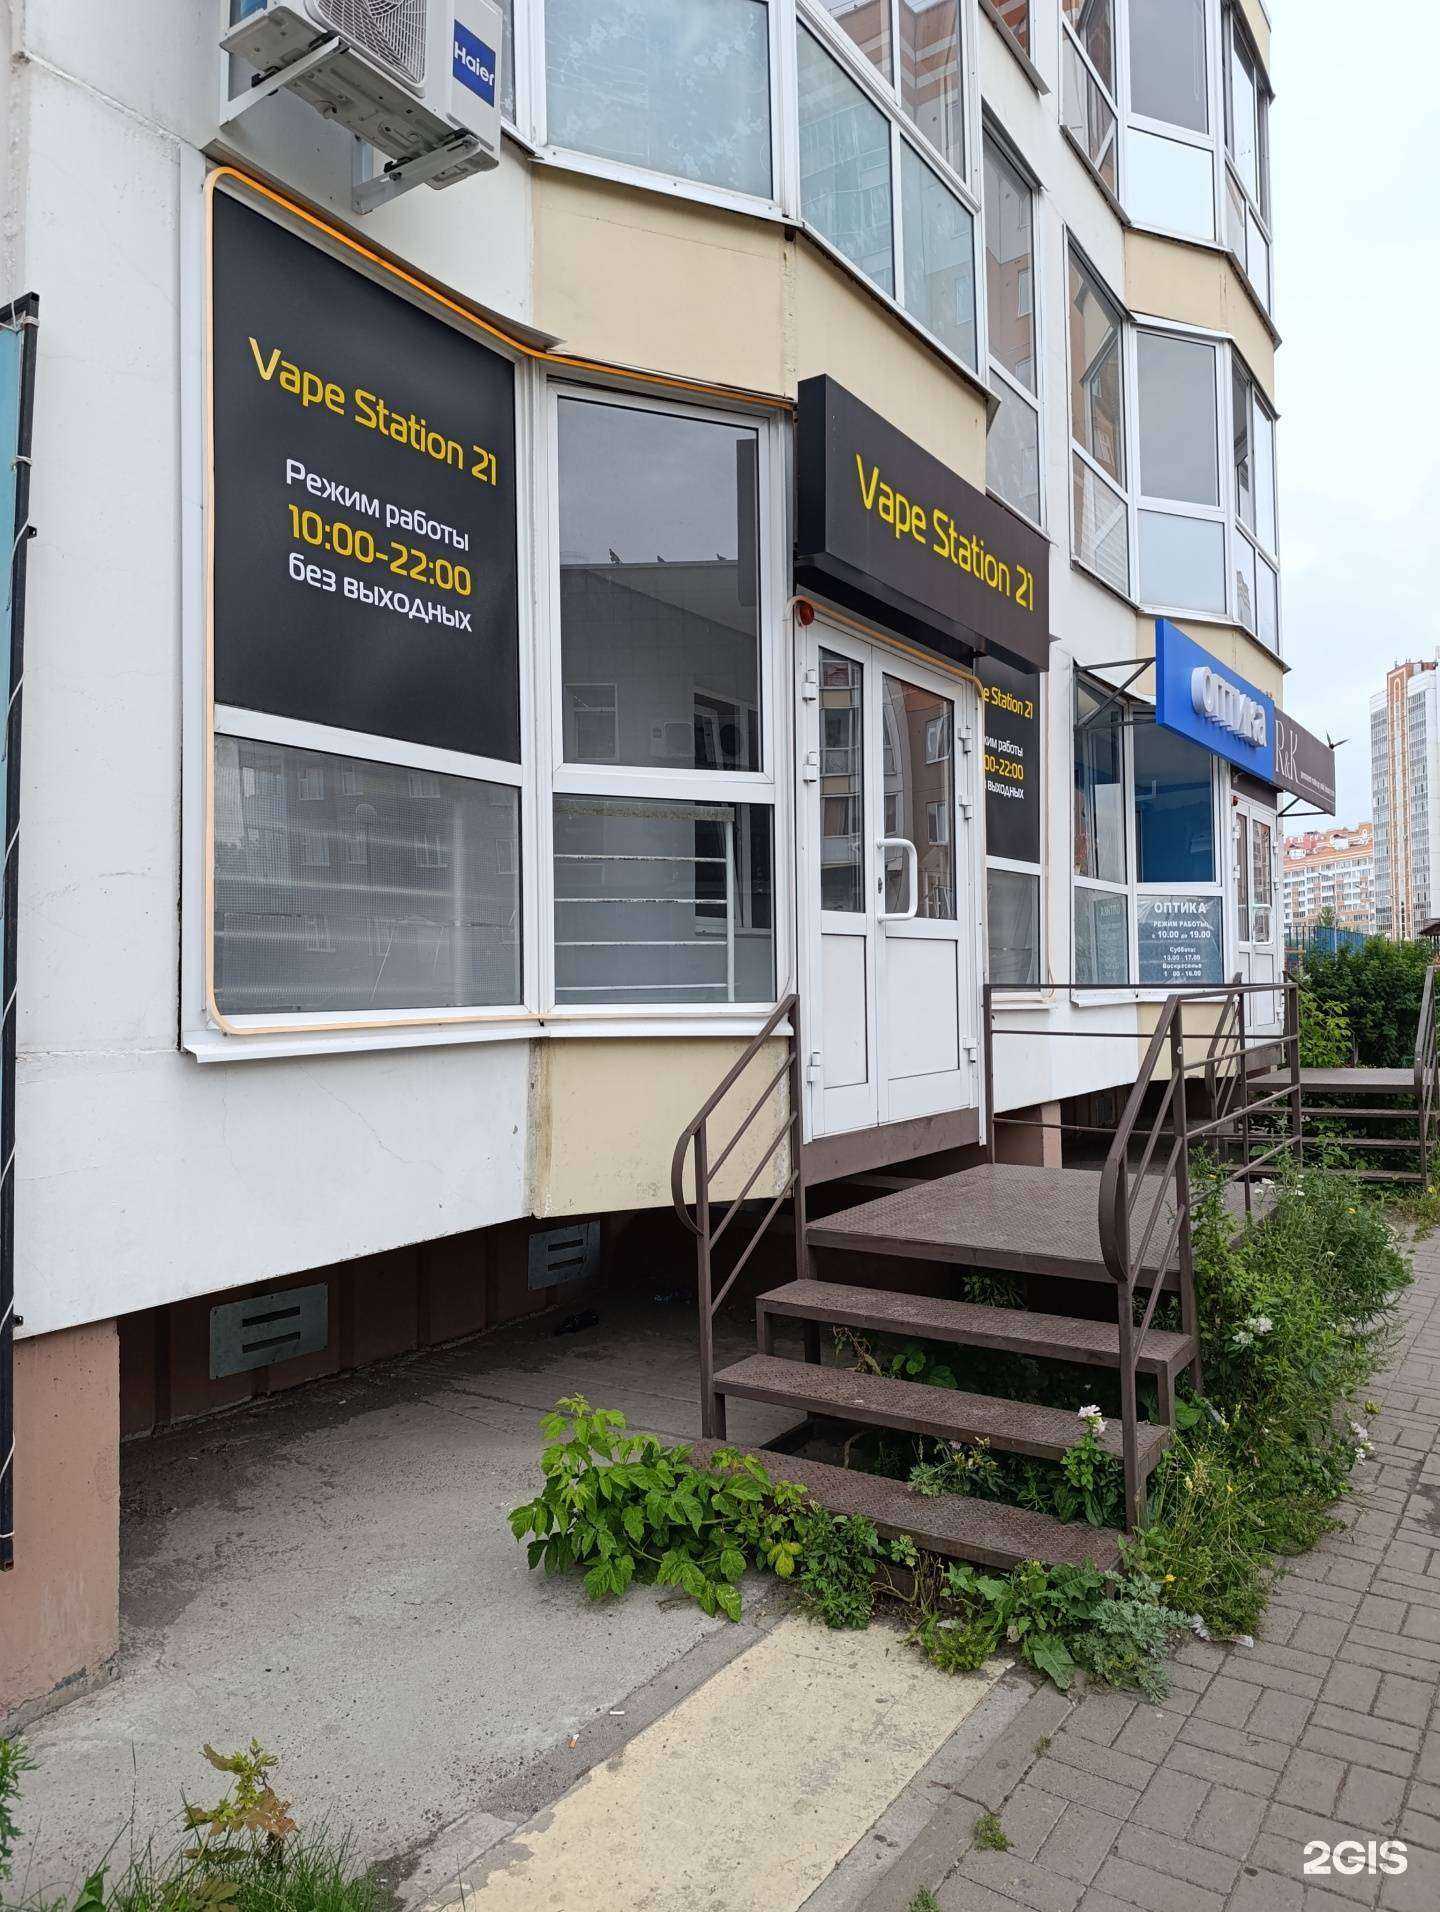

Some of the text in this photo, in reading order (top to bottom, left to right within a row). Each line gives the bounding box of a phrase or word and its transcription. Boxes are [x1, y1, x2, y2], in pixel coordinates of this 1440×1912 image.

[454, 41, 495, 87] Haier
[248, 336, 497, 486] Vape Station 21
[285, 457, 470, 551] Режим работы
[855, 452, 1035, 612] Vape Station 21
[287, 503, 472, 597] 10:00-22:00
[288, 551, 473, 633] без выходных
[991, 687, 1024, 716] Station
[1024, 700, 1034, 719] 21
[998, 740, 1024, 756] работы
[1275, 719, 1300, 783] R&K
[987, 781, 1025, 799] выходных
[1153, 902, 1207, 914] ОПТИКА
